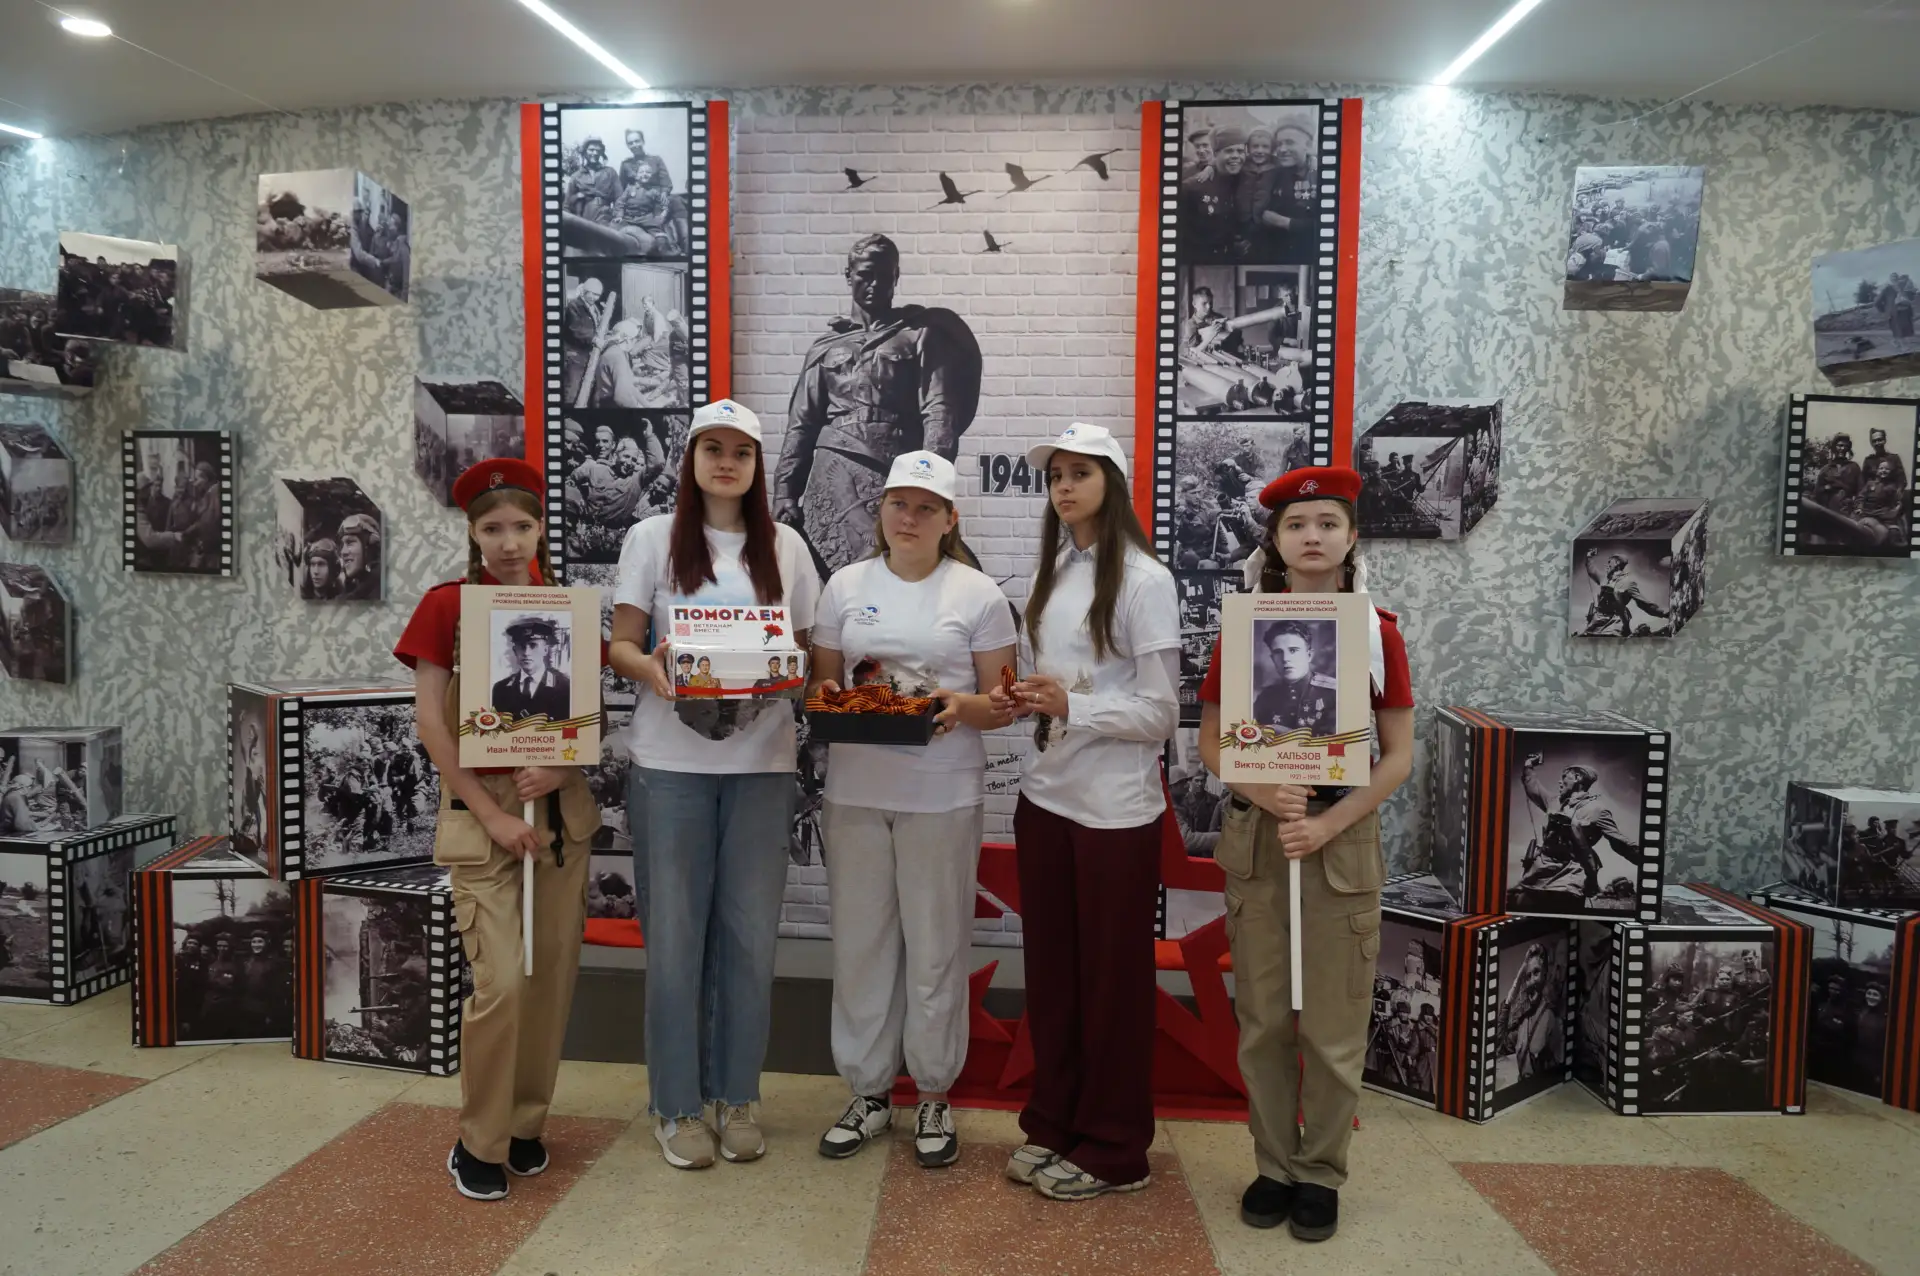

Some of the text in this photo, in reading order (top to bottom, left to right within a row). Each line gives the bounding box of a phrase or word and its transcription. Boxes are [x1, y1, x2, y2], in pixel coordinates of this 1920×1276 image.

[978, 453, 1046, 495] 1941
[674, 608, 784, 621] ПОМОГАЕМ
[511, 735, 556, 744] ПОЛЯКОВ
[486, 745, 555, 754] Иван Матвеевич
[1276, 751, 1321, 761] ХАЛЬЗОВ
[1234, 760, 1321, 771] Виктор Степанович
